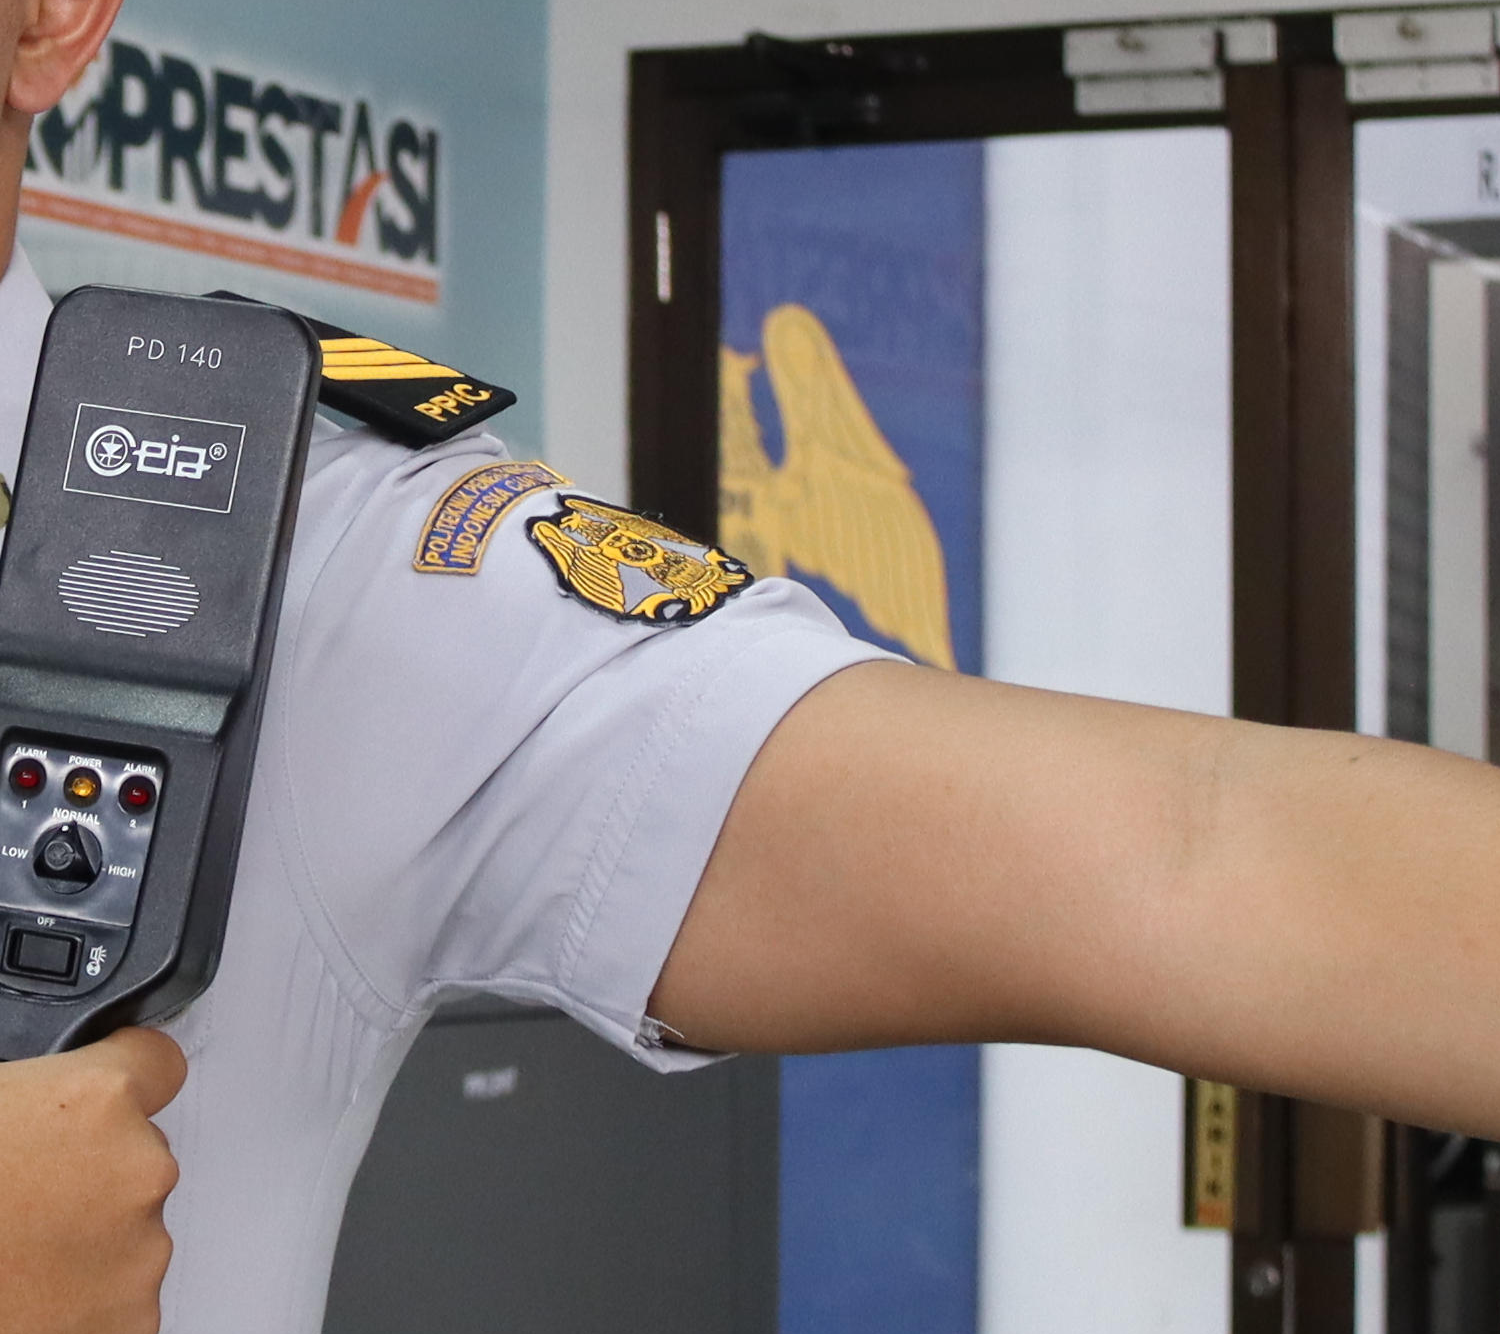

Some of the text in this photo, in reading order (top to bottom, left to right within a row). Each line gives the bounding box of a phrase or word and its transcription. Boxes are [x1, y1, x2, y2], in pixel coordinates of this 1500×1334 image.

[127, 336, 222, 369] PD 140
[414, 383, 492, 422] PPIC
[449, 487, 514, 565] INDONESIA
[15, 746, 157, 774] ALARM POWER ALARM
[21, 800, 28, 809] 1
[52, 807, 101, 825] NORMAL
[129, 819, 137, 828] 2
[1, 846, 29, 859] LOW
[108, 865, 136, 878] HIGH
[37, 917, 56, 927] OFF
